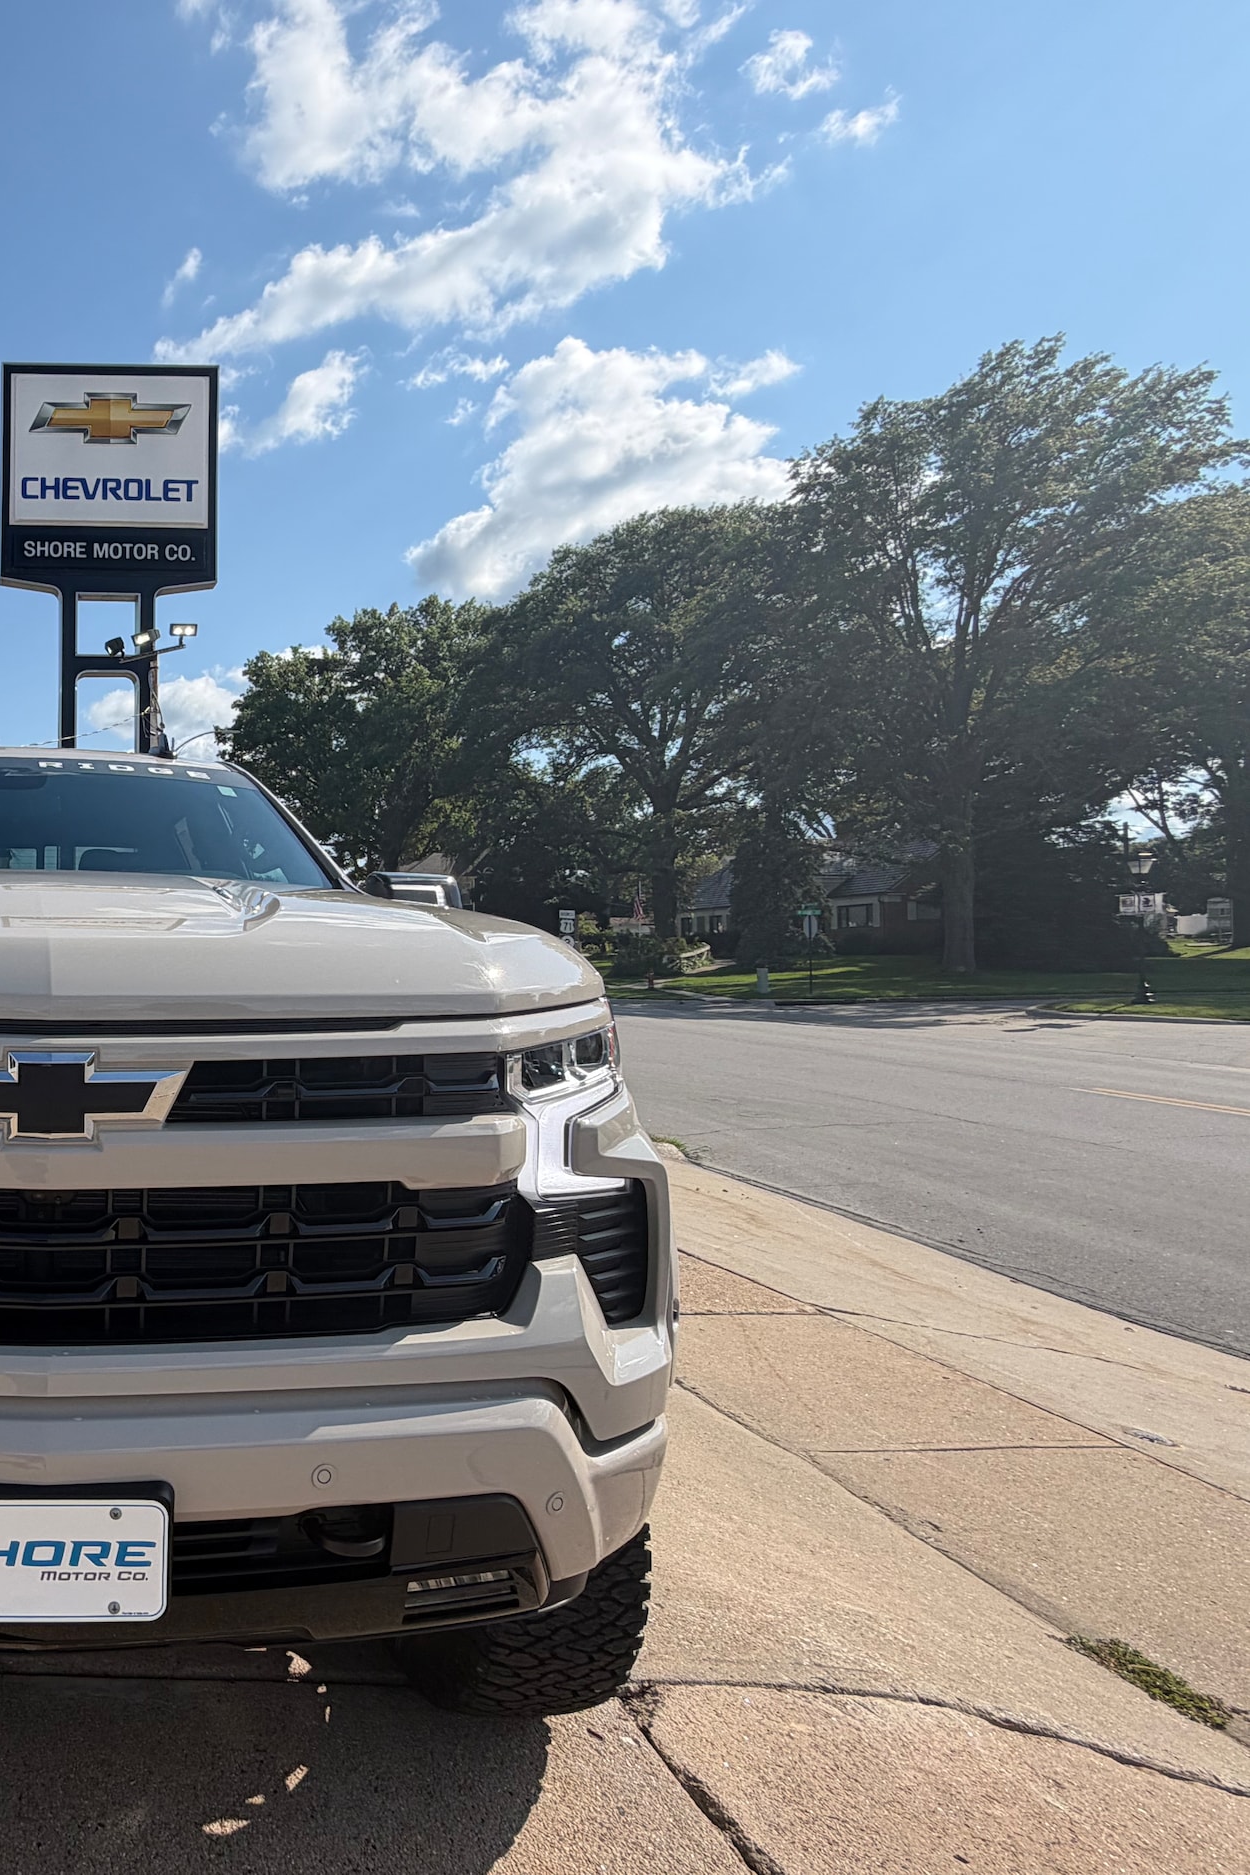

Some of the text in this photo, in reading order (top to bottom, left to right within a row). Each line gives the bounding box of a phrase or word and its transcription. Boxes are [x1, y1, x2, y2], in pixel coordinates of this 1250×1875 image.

[21, 477, 199, 502] CHEVROLET
[23, 541, 197, 563] SHORE MOTOR CO.
[38, 761, 211, 780] RIDGE
[562, 922, 572, 932] 71
[40, 1570, 111, 1582] MOTOR
